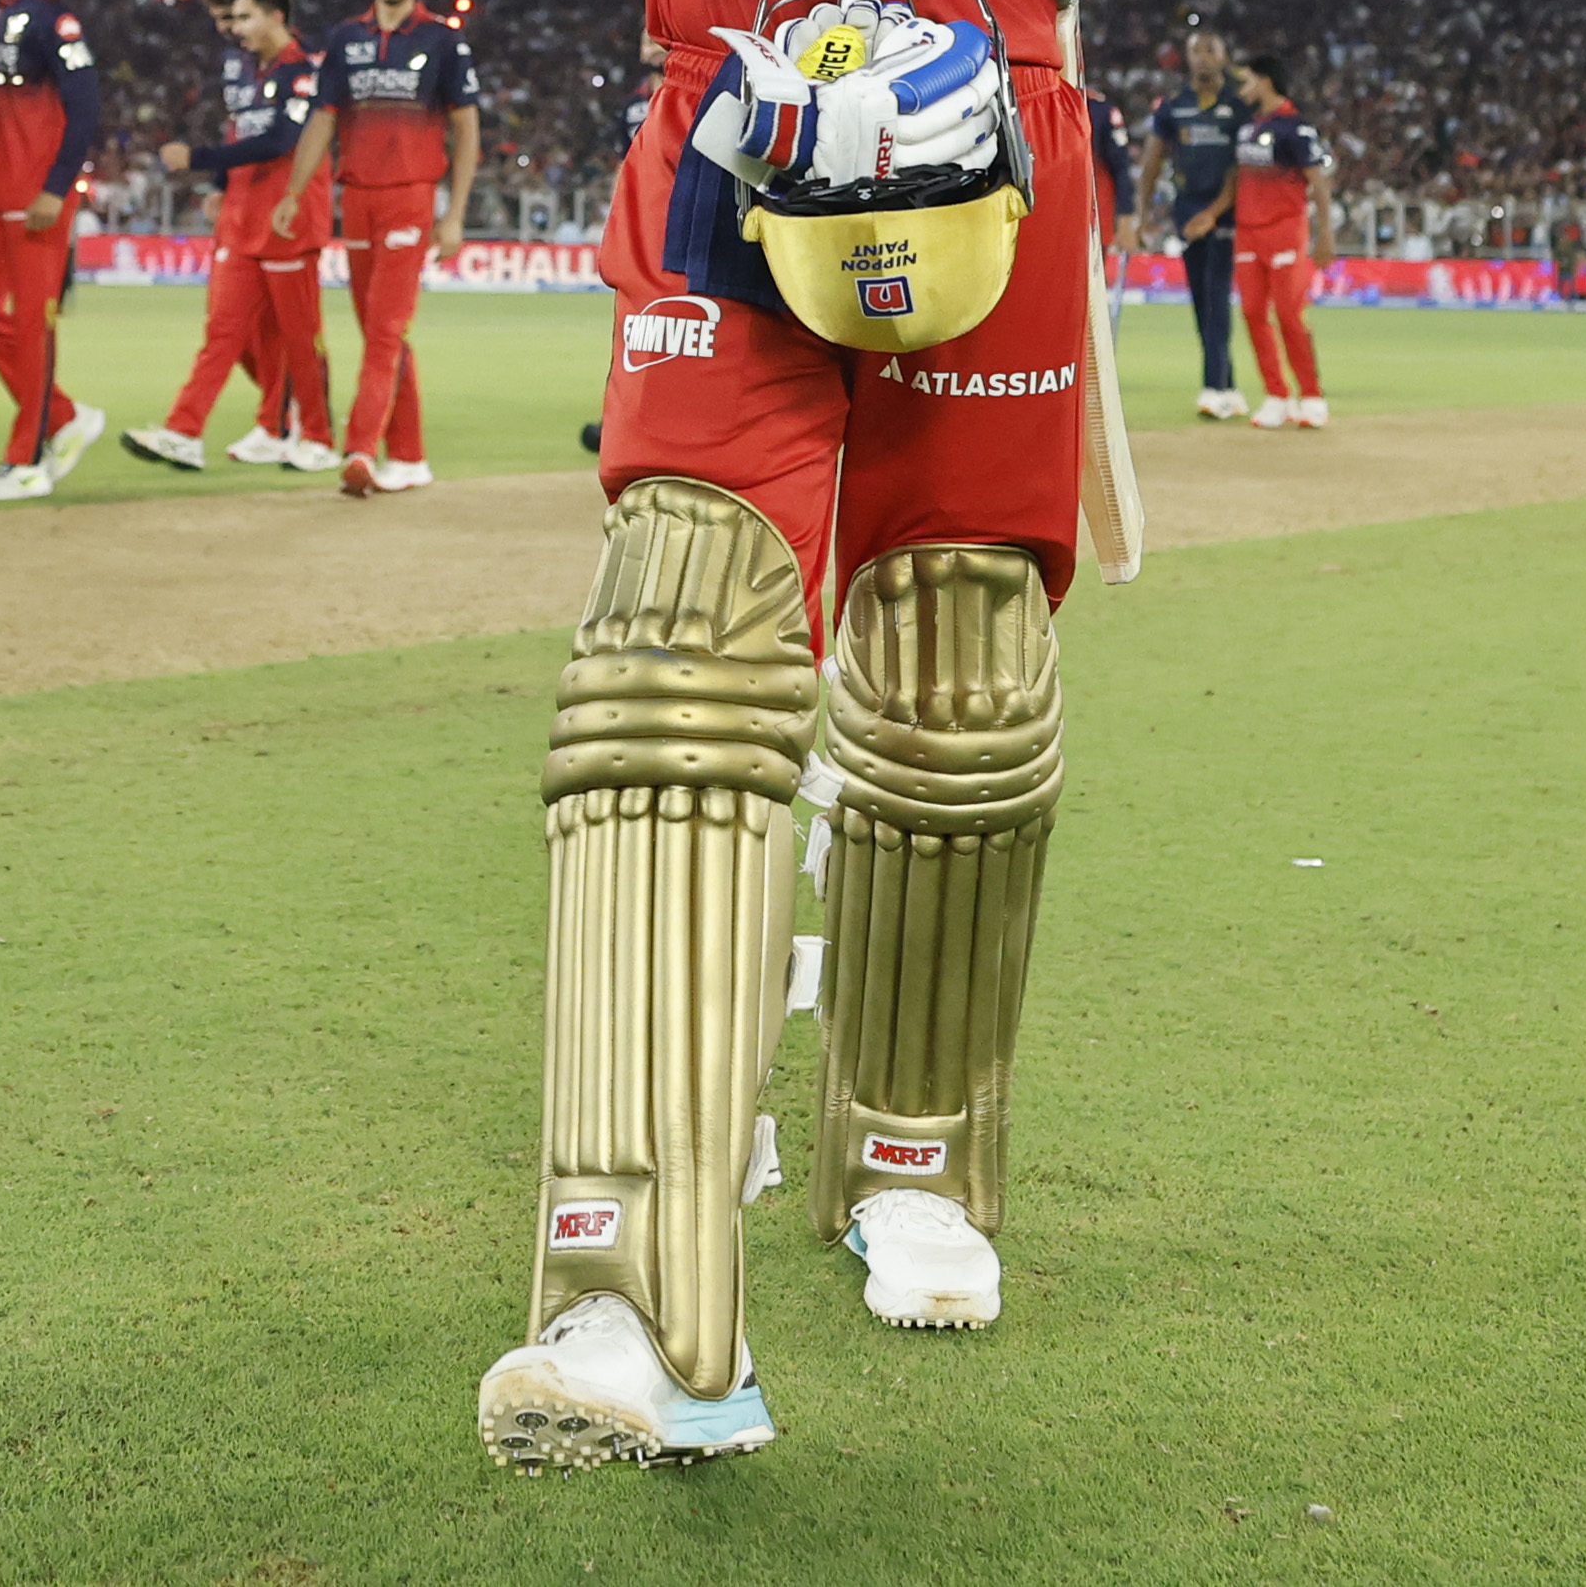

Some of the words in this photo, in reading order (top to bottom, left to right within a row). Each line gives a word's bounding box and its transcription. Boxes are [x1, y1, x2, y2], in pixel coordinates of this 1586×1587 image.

[841, 253, 917, 271] NIPPON
[851, 239, 909, 258] PAINT
[623, 314, 716, 358] EMMVEE
[910, 362, 1076, 396] ATLASSIAN
[869, 1139, 943, 1168] MRF
[554, 1210, 615, 1241] MRF
